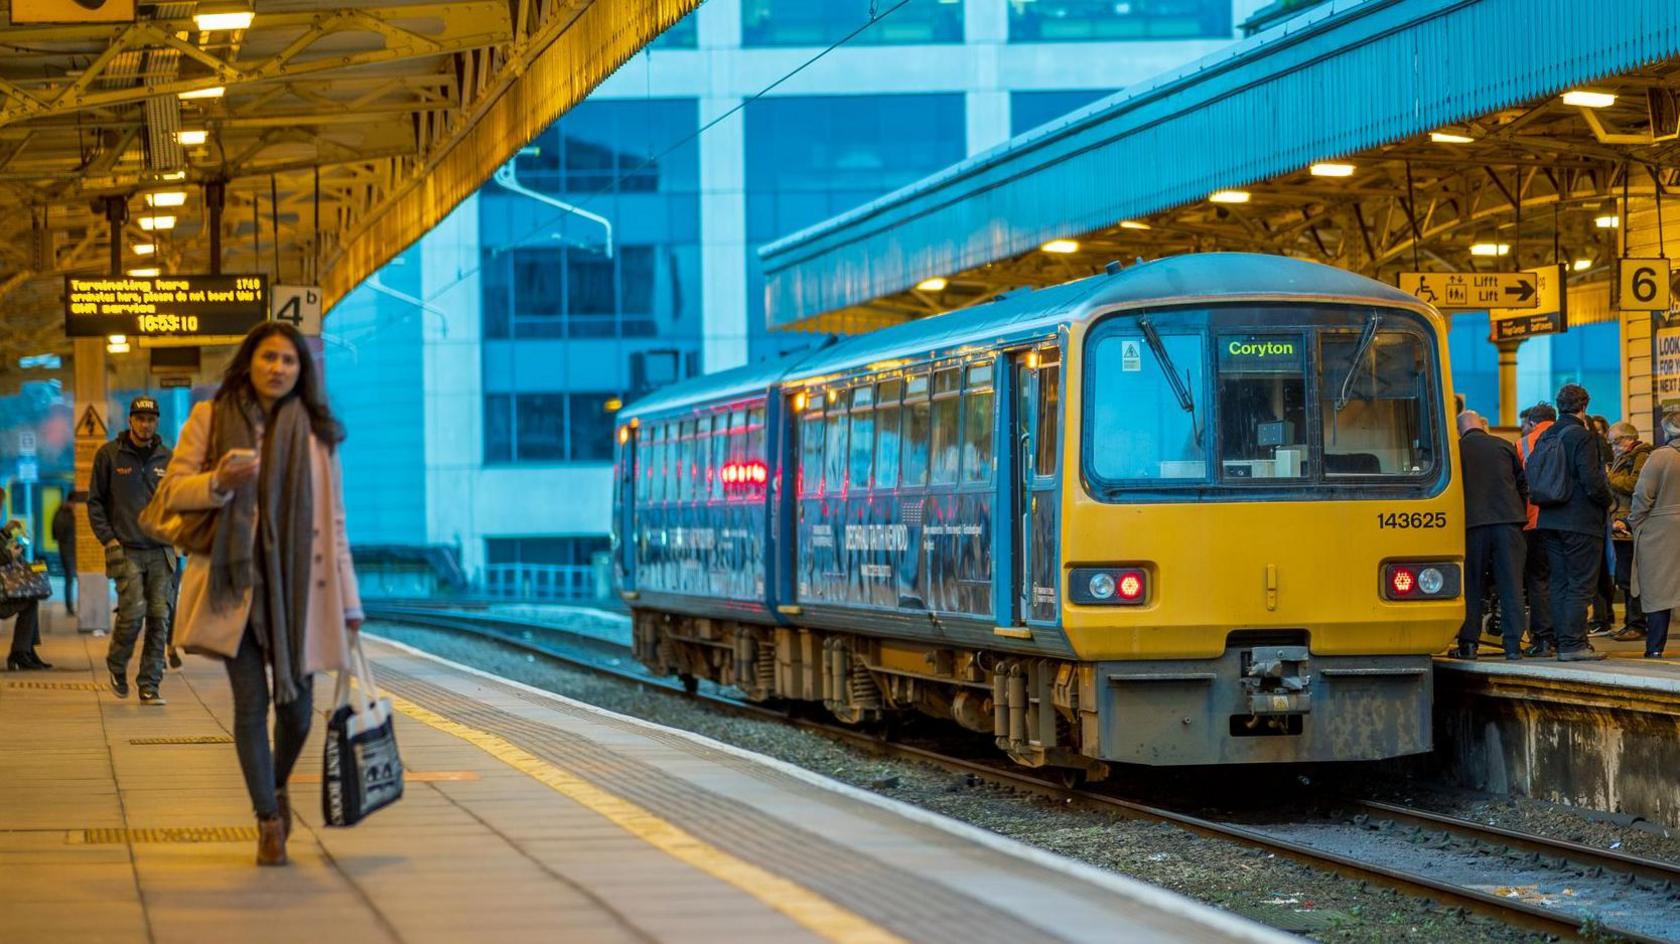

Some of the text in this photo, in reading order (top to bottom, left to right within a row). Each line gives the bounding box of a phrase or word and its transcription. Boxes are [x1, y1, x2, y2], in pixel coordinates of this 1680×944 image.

[71, 279, 190, 292] Terminating here
[1474, 276, 1498, 287] Lifft
[1632, 267, 1657, 303] 6
[1479, 290, 1498, 301] Lift
[102, 302, 156, 314] service
[1229, 341, 1293, 357] Coryton
[1660, 359, 1674, 375] FOR
[1377, 511, 1447, 529] 143625
